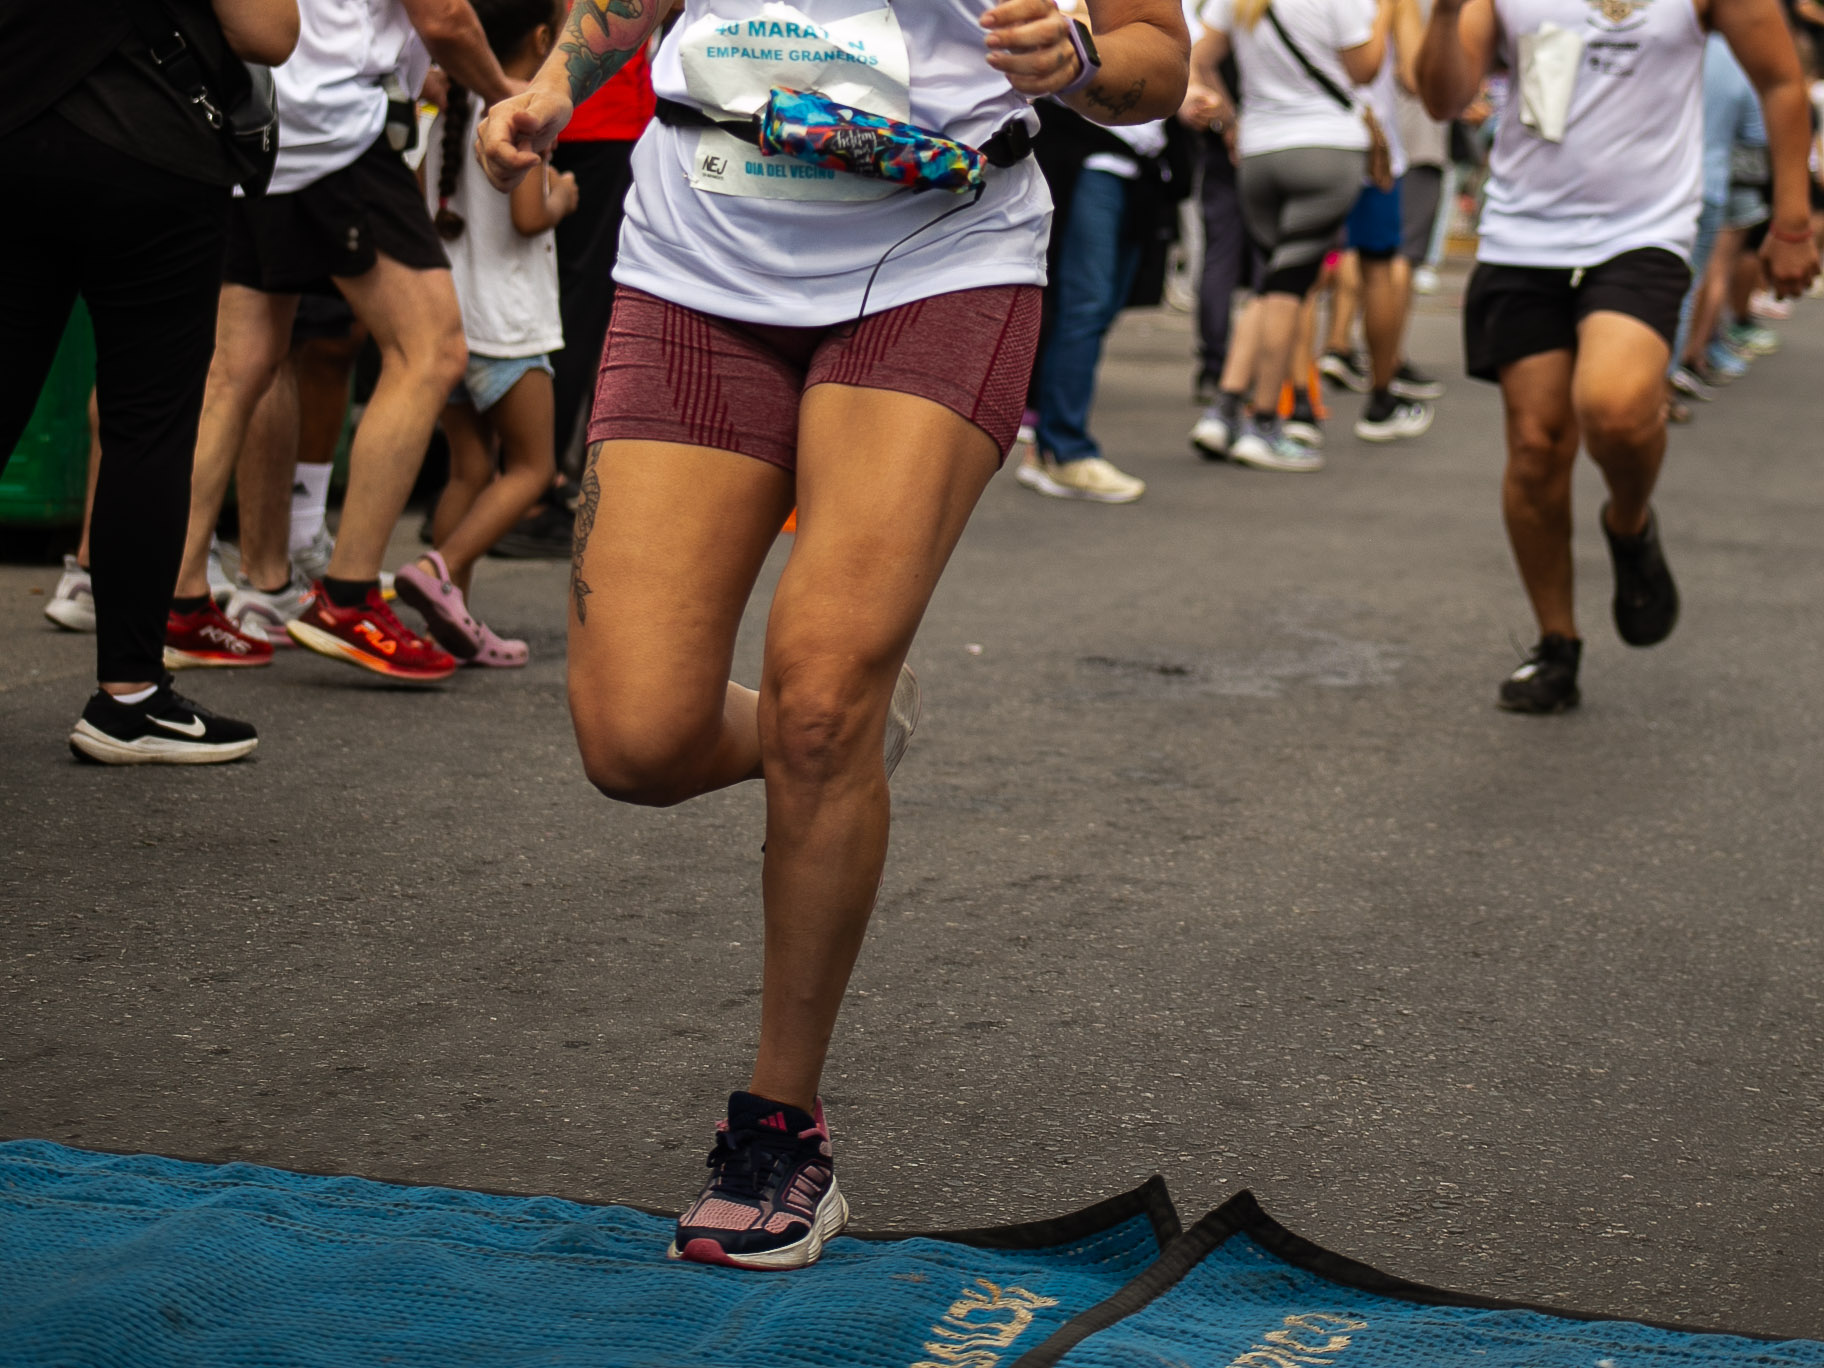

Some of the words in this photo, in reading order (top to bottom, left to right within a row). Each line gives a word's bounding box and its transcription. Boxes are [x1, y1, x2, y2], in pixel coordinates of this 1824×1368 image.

[706, 46, 783, 61] EMPALME
[789, 48, 879, 66] GRANEROS
[745, 161, 764, 177] DIA
[766, 163, 788, 178] DEL
